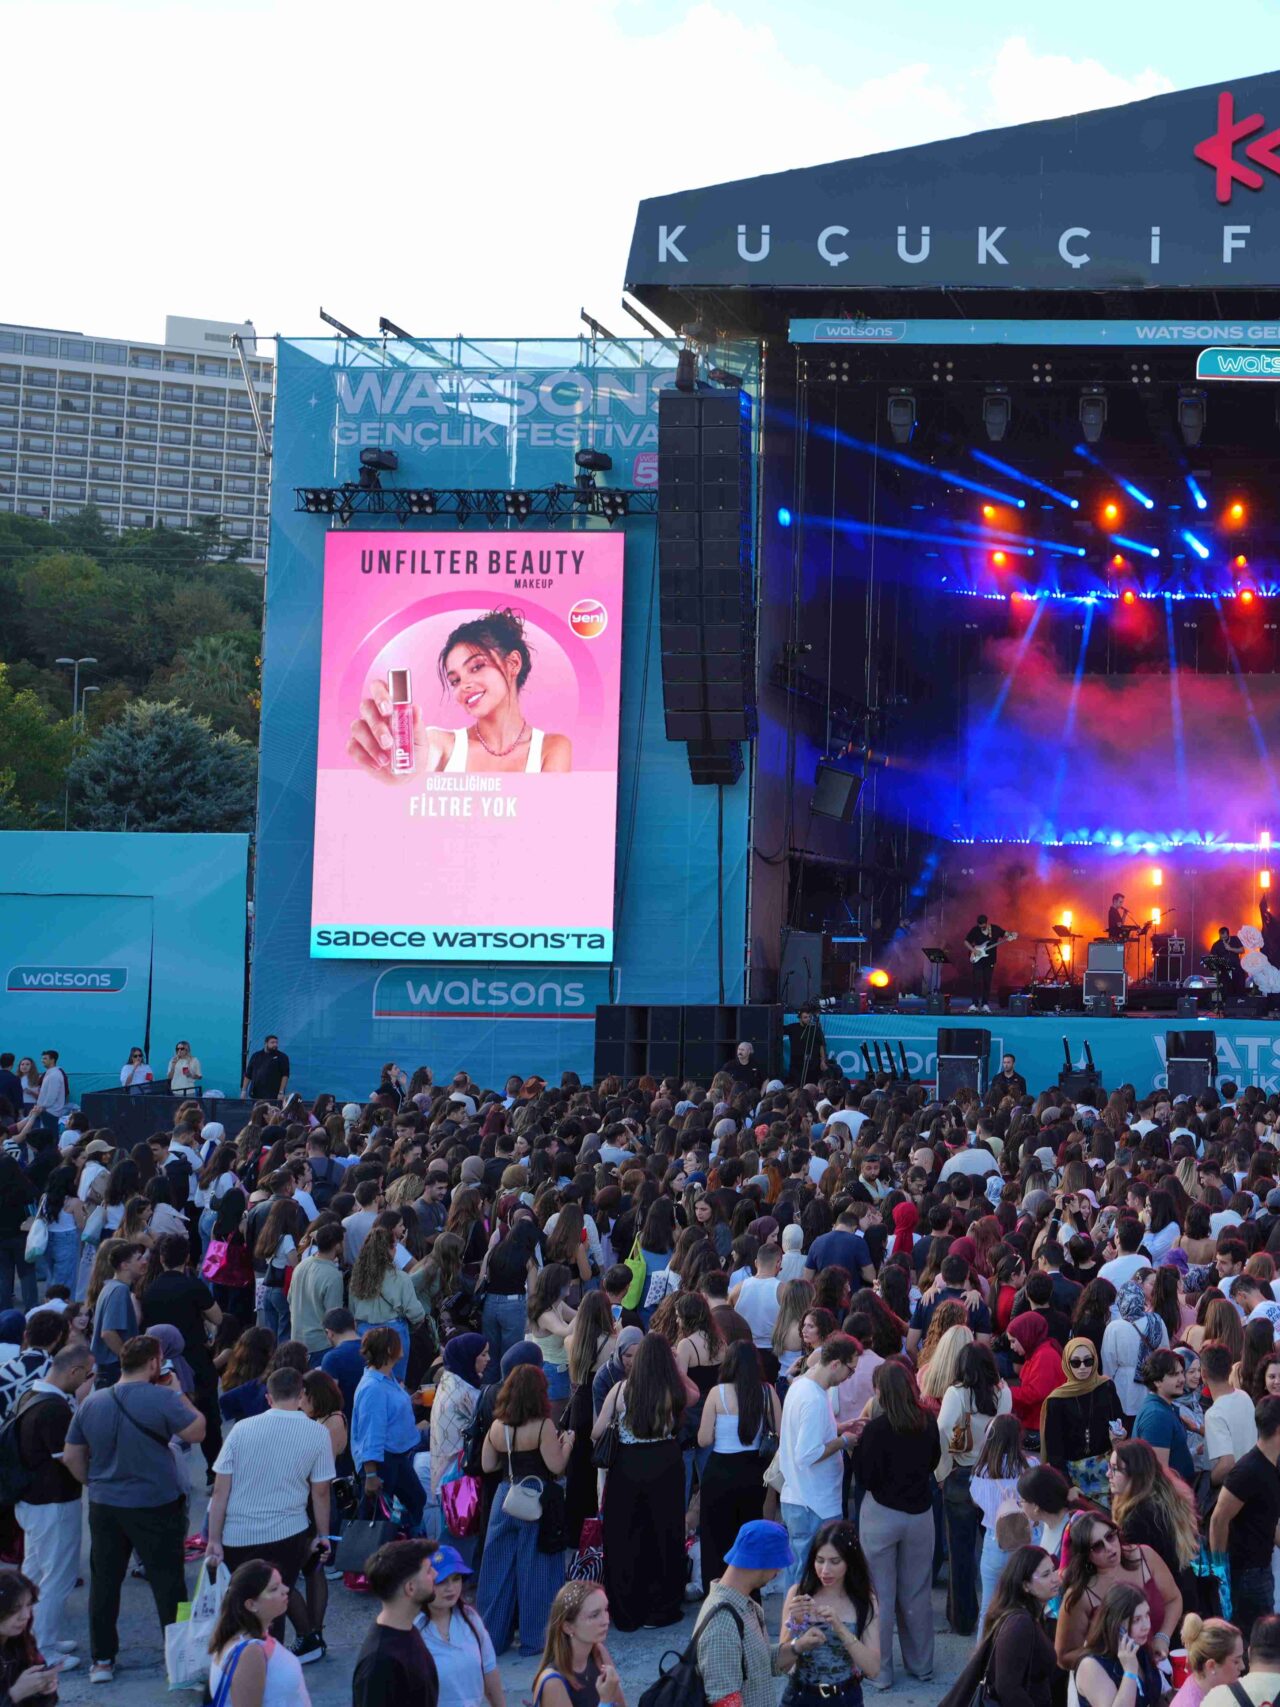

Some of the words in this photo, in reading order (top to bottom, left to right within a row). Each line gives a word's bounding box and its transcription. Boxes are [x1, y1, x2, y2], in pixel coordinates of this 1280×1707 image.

[826, 325, 893, 337] watsons
[1136, 325, 1244, 339] WATSONS
[332, 416, 499, 452] GENÇLİK
[505, 416, 658, 447] FESTİVA
[360, 549, 478, 575] UNFILTER
[488, 549, 585, 575] BEAUTY
[514, 578, 554, 589] MAKEUP
[410, 793, 472, 817] FİLTRE
[481, 796, 518, 817] YOK
[22, 971, 111, 987] watsons
[405, 977, 586, 1008] watsons
